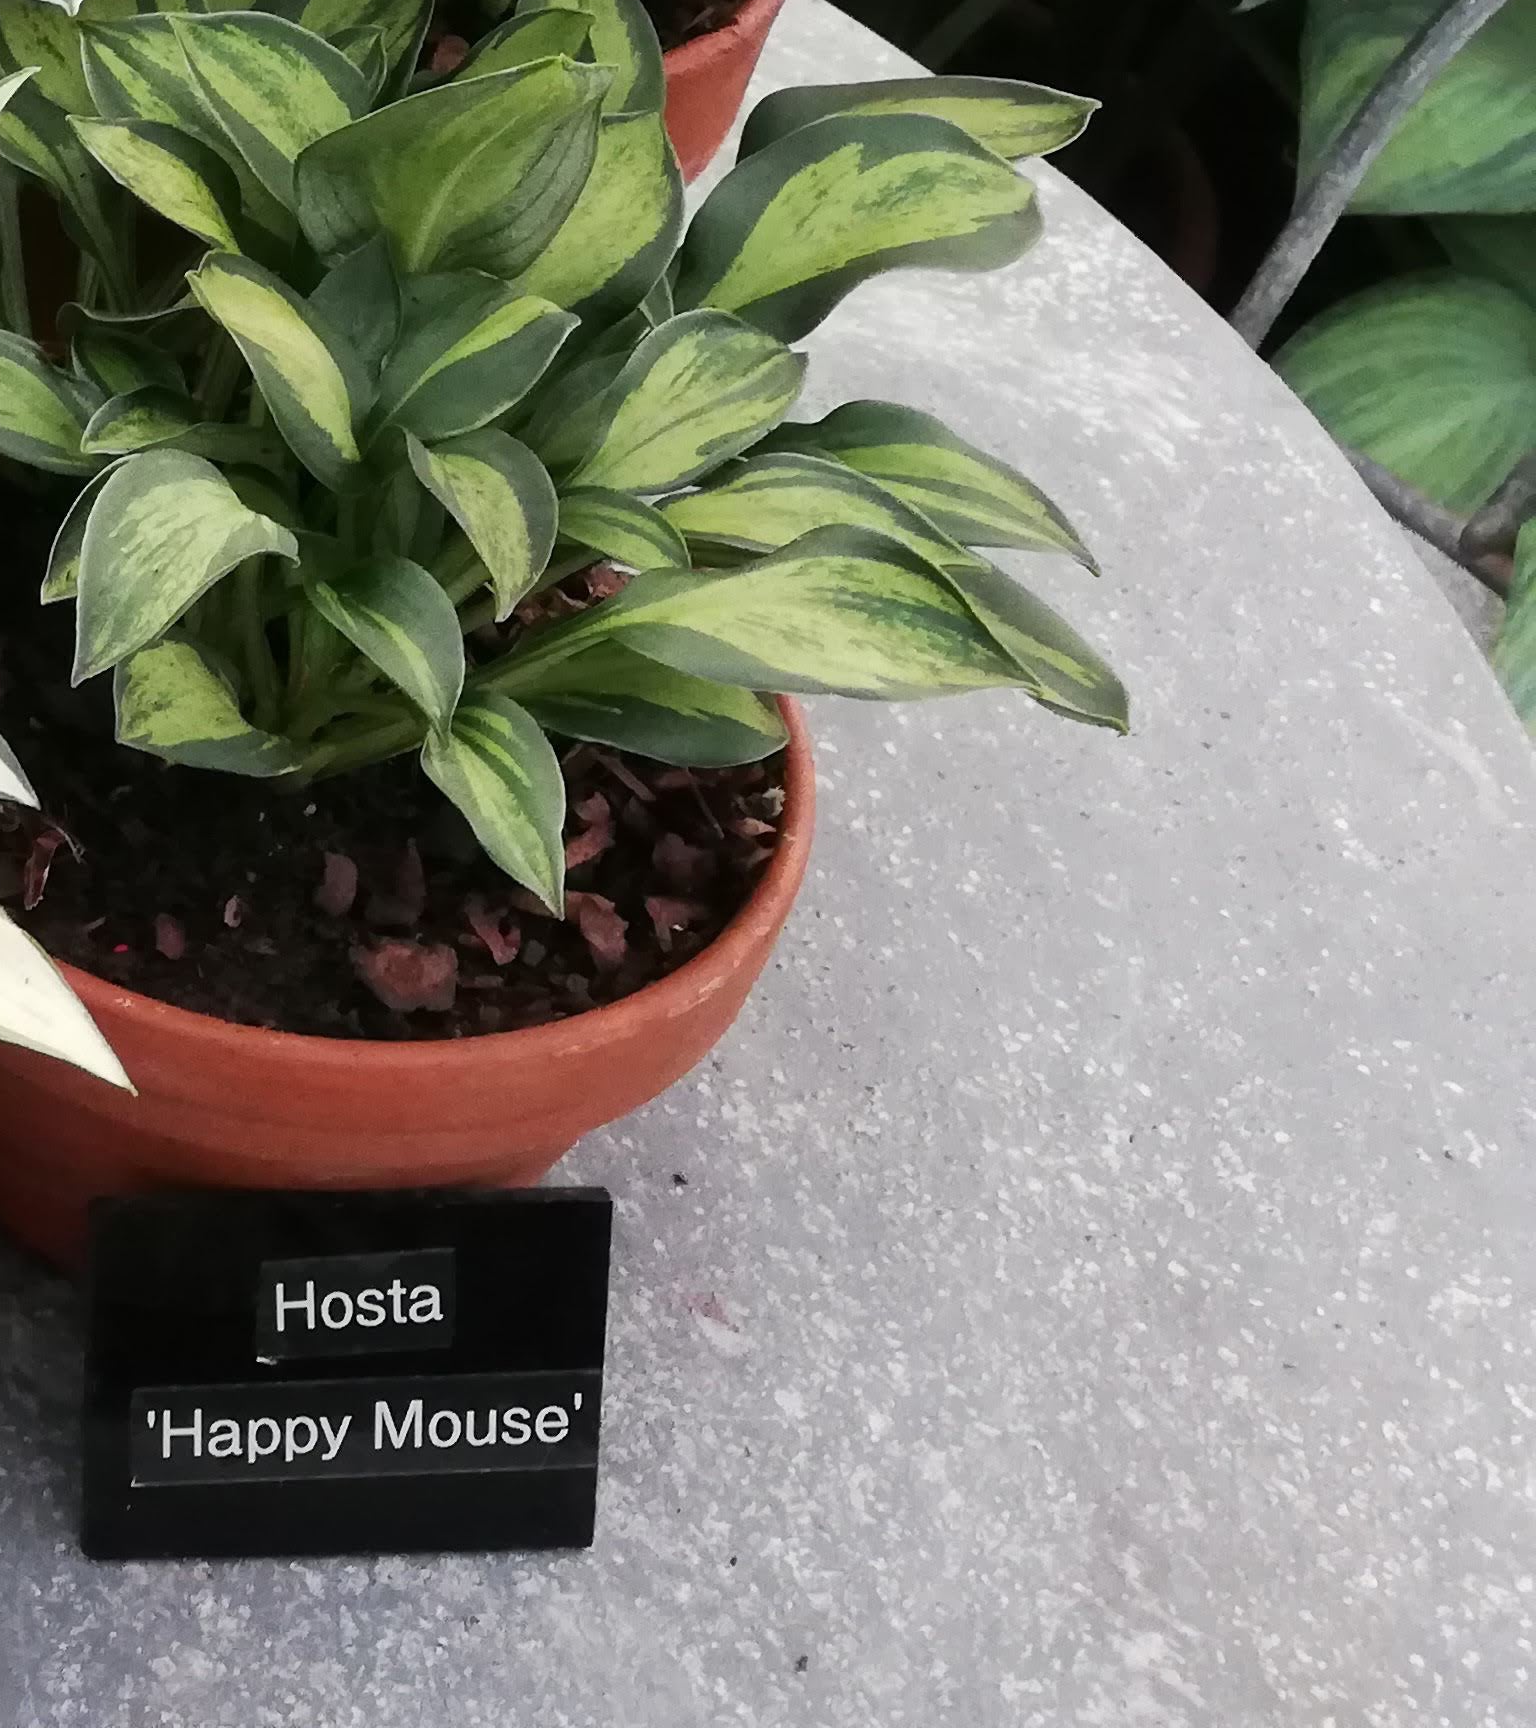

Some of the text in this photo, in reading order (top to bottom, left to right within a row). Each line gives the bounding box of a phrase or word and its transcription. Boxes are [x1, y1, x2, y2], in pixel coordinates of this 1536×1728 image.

[275, 1279, 445, 1332] Hosta
[146, 1392, 584, 1465] 'Happy Mouse'
